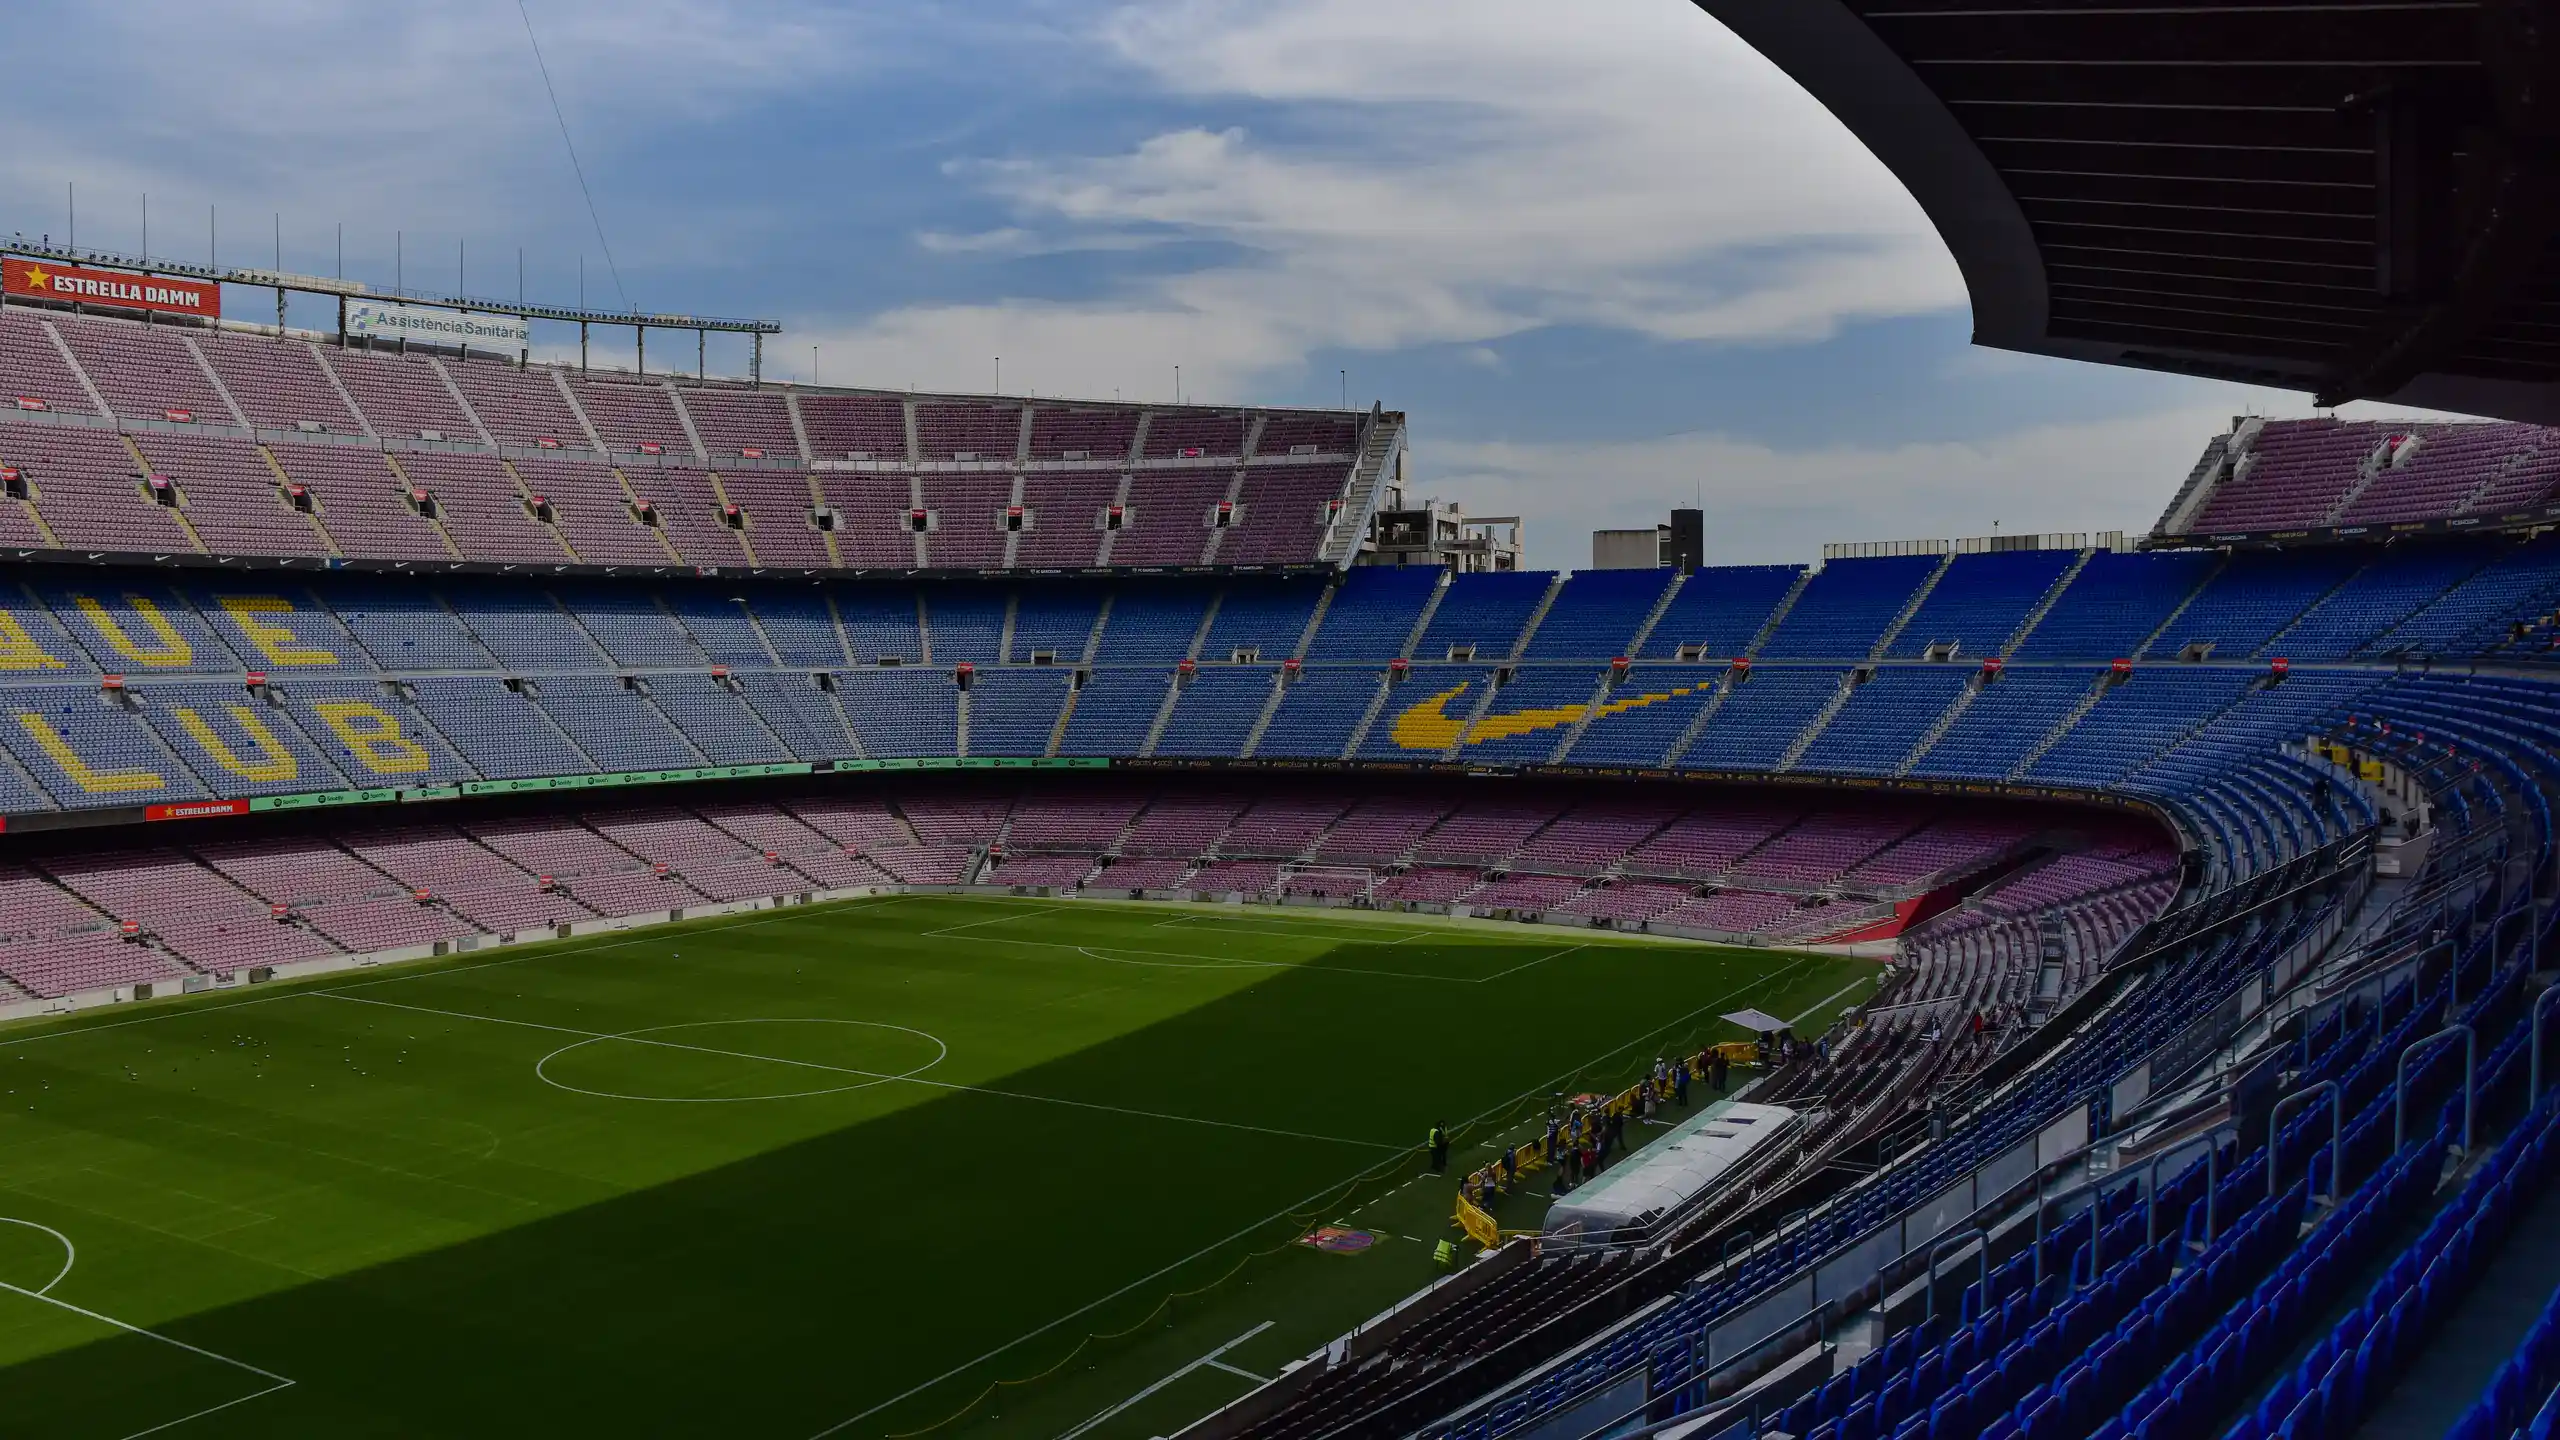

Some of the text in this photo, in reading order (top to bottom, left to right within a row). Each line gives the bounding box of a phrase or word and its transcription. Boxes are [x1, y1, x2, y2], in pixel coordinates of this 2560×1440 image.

[54, 275, 200, 307] ESTRELLA DAMM
[377, 312, 527, 339] Assistència Sanitària
[283, 798, 300, 806] Spotify
[176, 807, 210, 816] ESTRELLA
